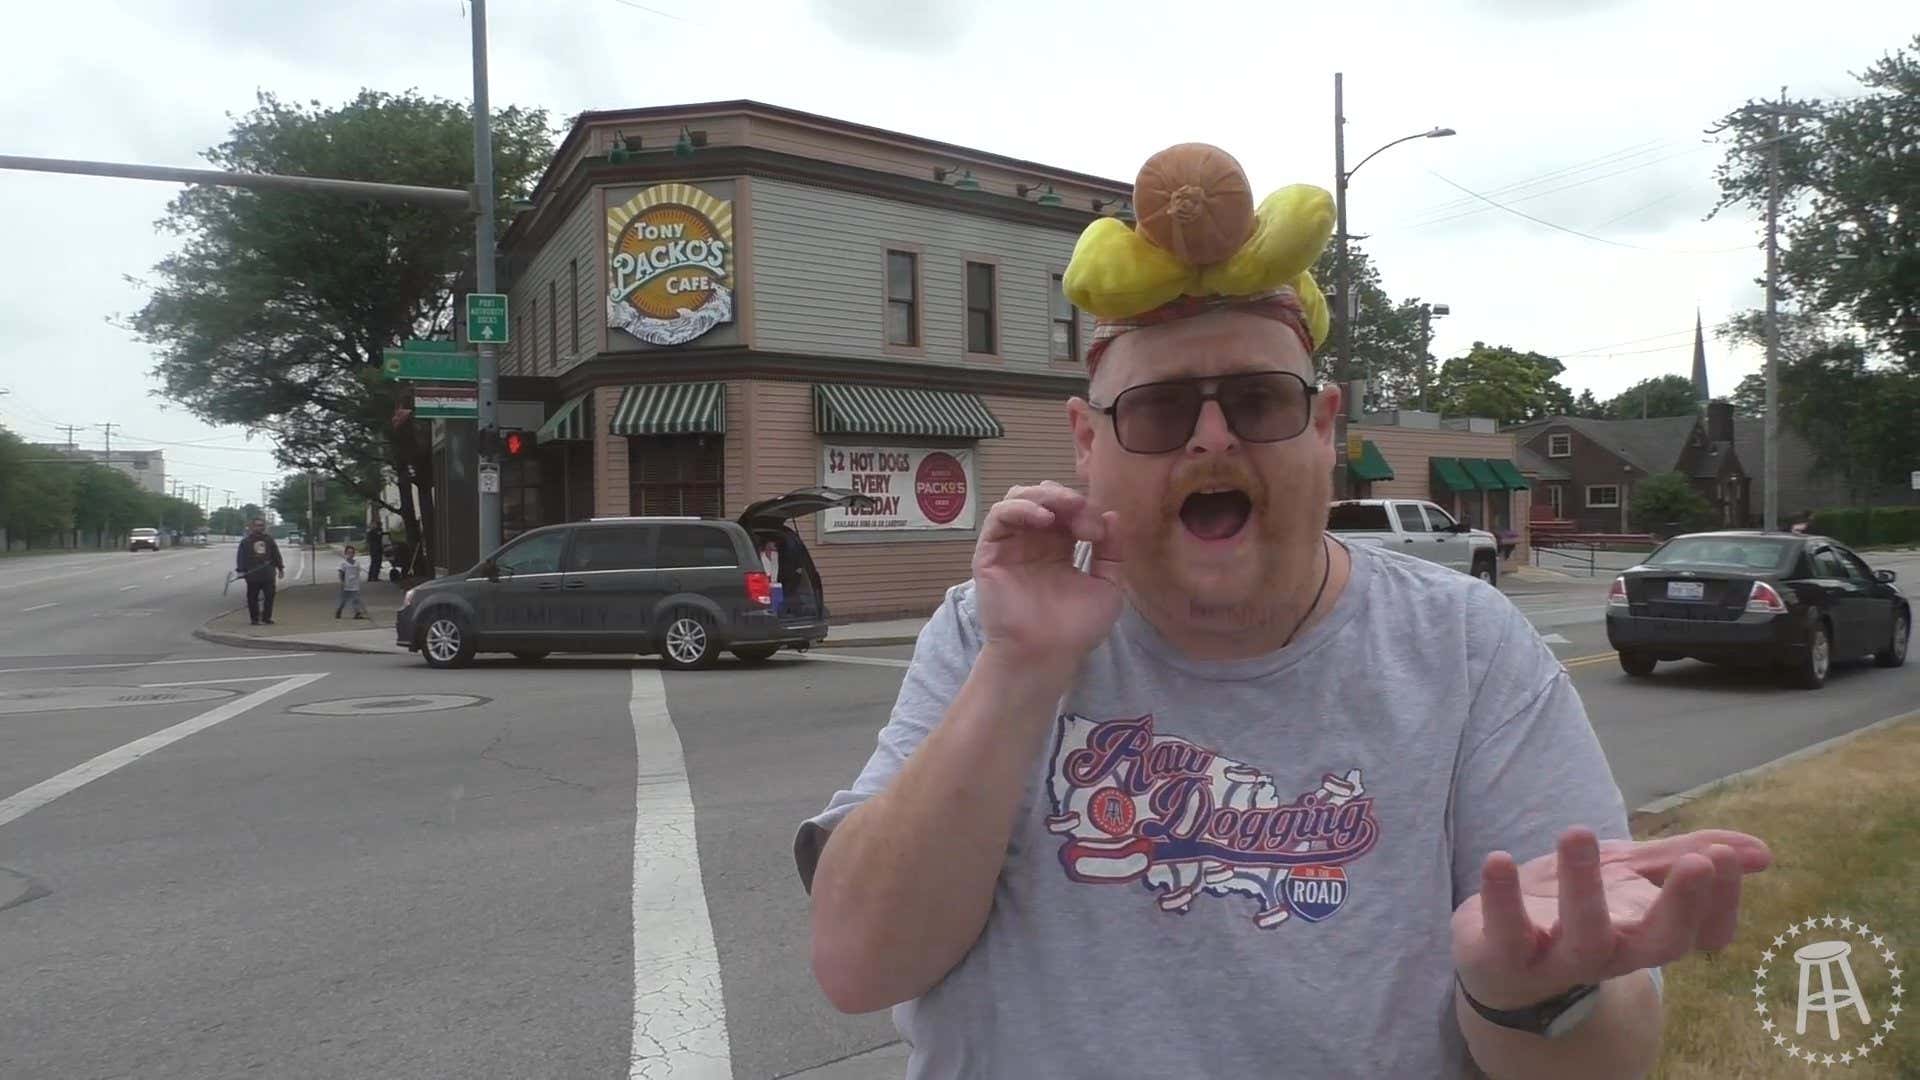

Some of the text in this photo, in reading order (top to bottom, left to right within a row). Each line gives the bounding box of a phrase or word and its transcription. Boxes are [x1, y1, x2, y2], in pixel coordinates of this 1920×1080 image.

[634, 222, 684, 240] TONY
[610, 238, 726, 302] PACKO'S
[666, 276, 709, 294] CAFE
[830, 448, 910, 473] $2 HOT DOGS
[851, 474, 891, 493] EVERY
[1064, 714, 1215, 796] Raw
[1134, 776, 1379, 862] Dogging
[1293, 880, 1343, 905] ROAD
